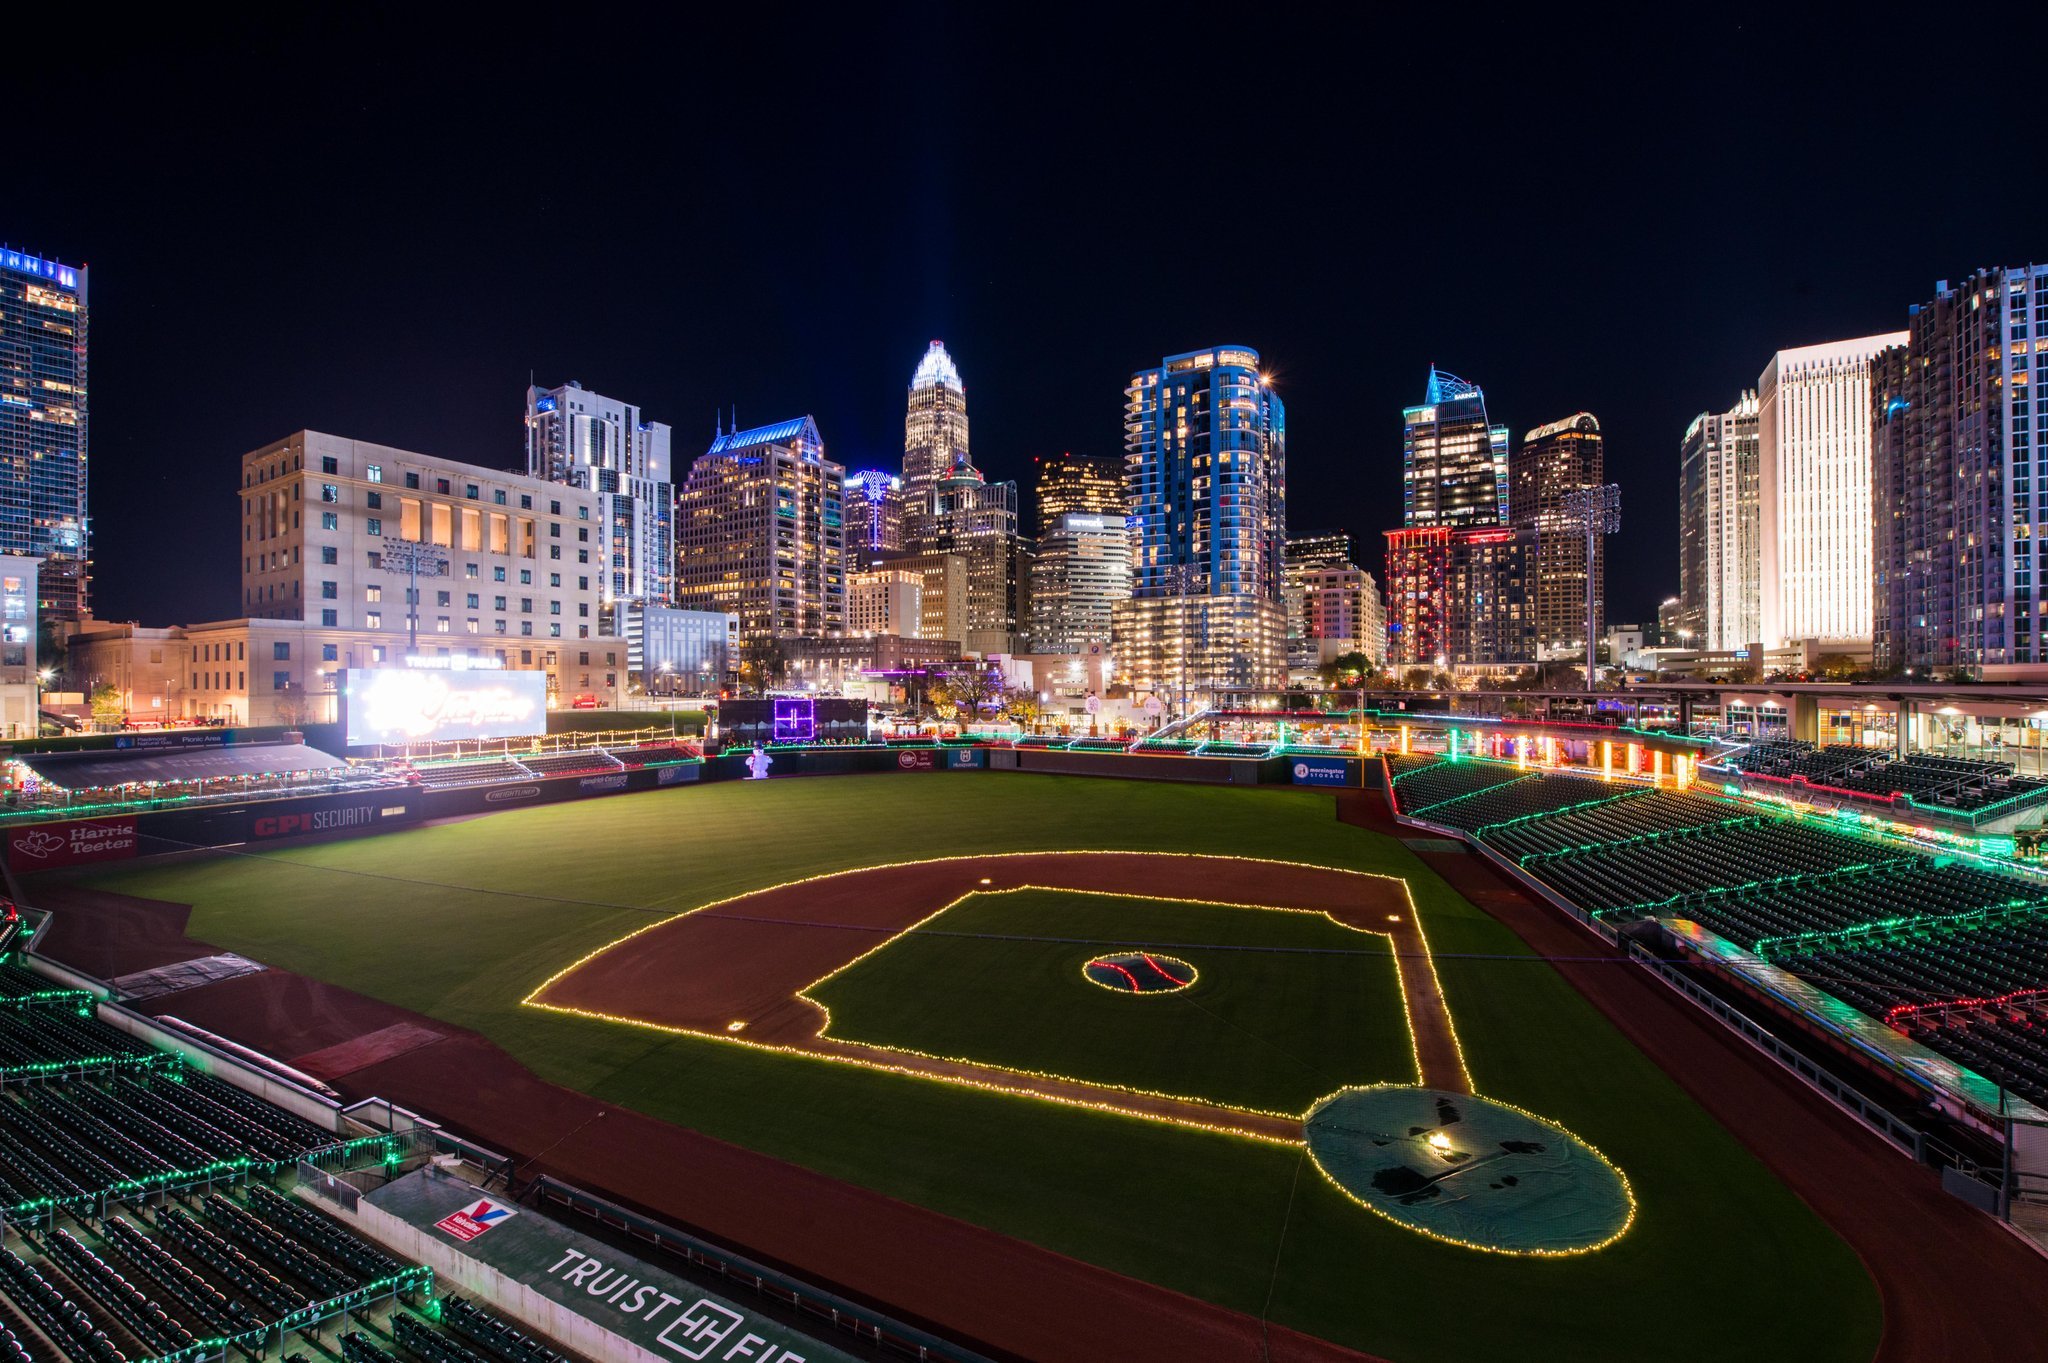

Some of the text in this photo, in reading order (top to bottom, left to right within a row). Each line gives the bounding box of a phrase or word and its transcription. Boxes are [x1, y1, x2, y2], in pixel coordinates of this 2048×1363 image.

[405, 656, 501, 669] TRUIST FIELD
[254, 806, 374, 837] CPI SECURITY
[70, 825, 133, 841] Harris
[70, 839, 133, 854] Teeter
[453, 1215, 481, 1232] Valvoline
[547, 1248, 683, 1322] TRUIST
